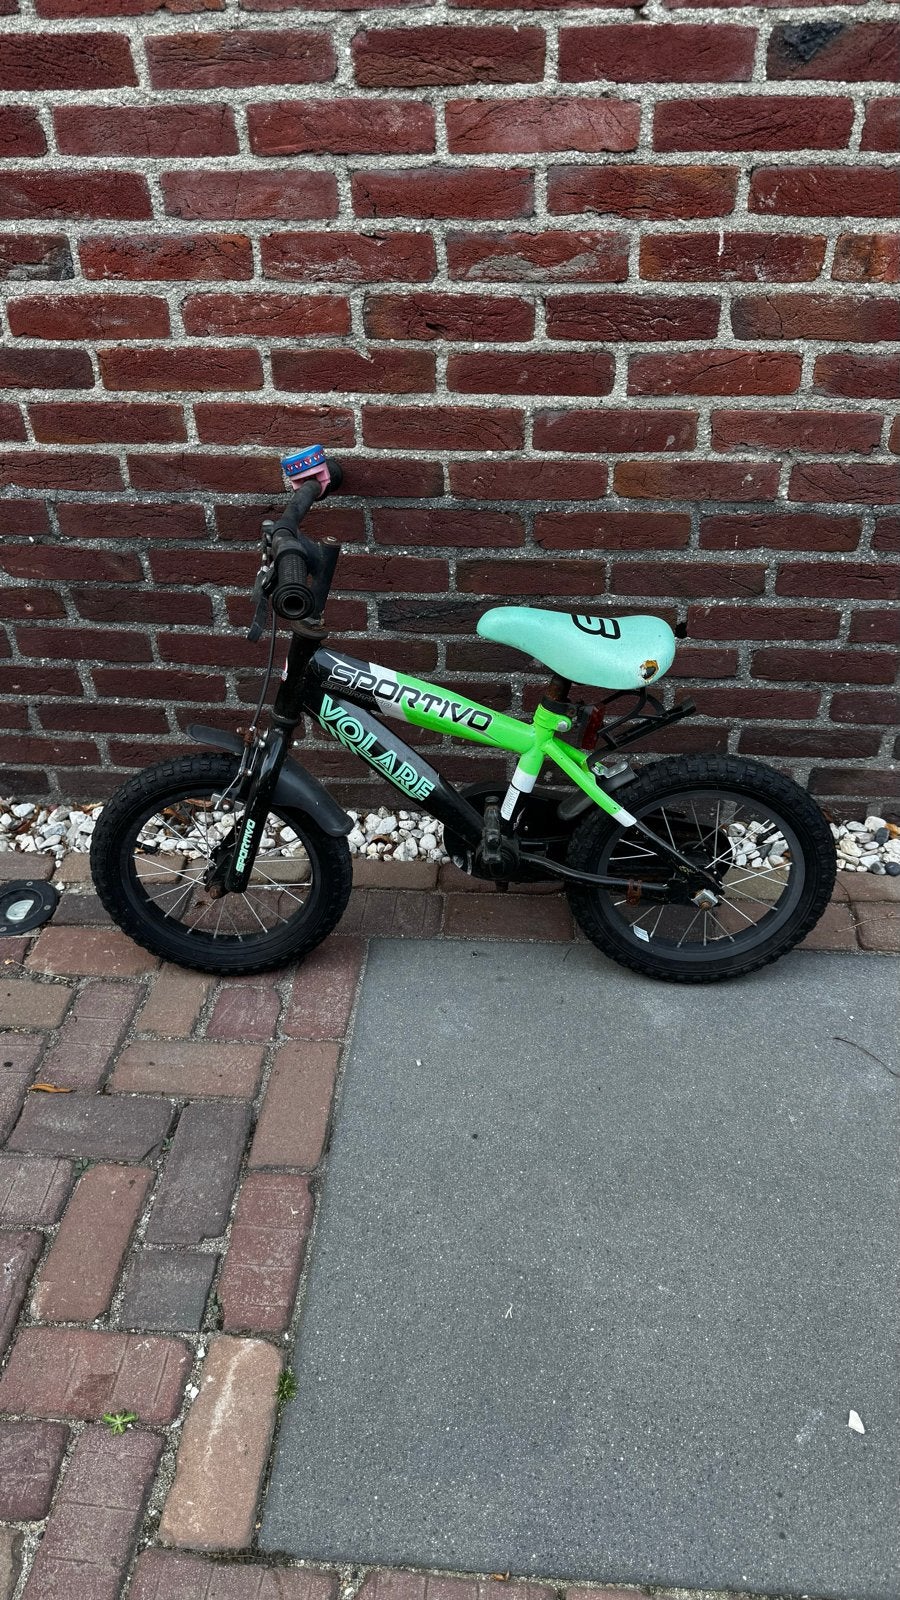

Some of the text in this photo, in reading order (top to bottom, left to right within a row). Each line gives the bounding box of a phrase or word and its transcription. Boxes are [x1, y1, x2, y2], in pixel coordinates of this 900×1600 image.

[328, 664, 493, 732] SPORTIVO
[319, 693, 436, 801] VOLARE
[235, 818, 256, 873] SPORTIVO
